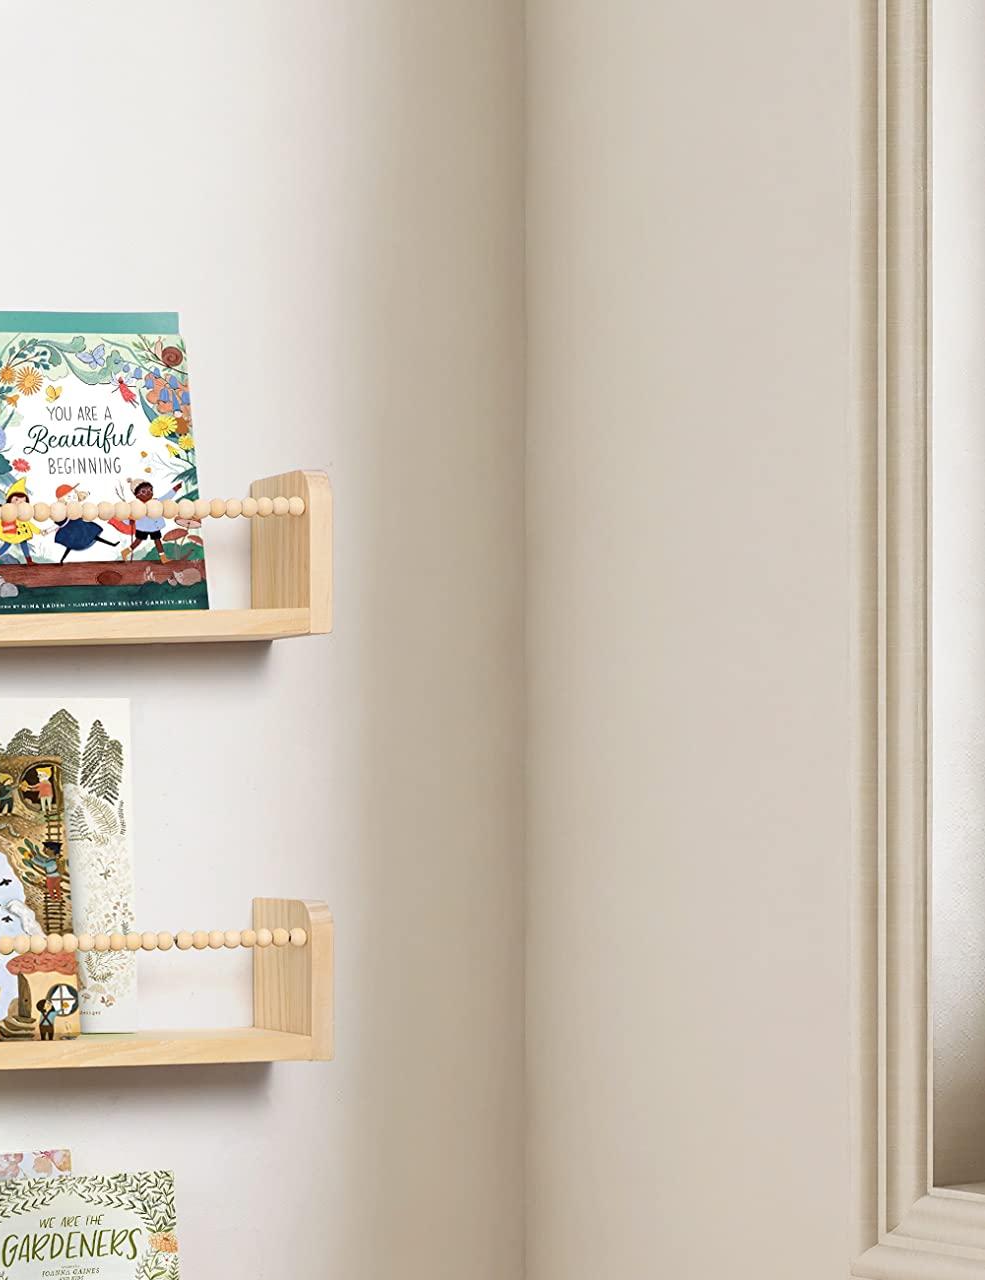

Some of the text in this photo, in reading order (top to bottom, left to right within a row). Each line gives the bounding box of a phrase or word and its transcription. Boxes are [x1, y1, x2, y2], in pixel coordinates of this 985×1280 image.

[46, 405, 113, 421] YOU ARE A
[23, 422, 137, 455] Beautiful
[48, 456, 122, 475] BEGINNING
[39, 1214, 105, 1229] WE ARE THE
[1, 1227, 143, 1268] GARDENERS
